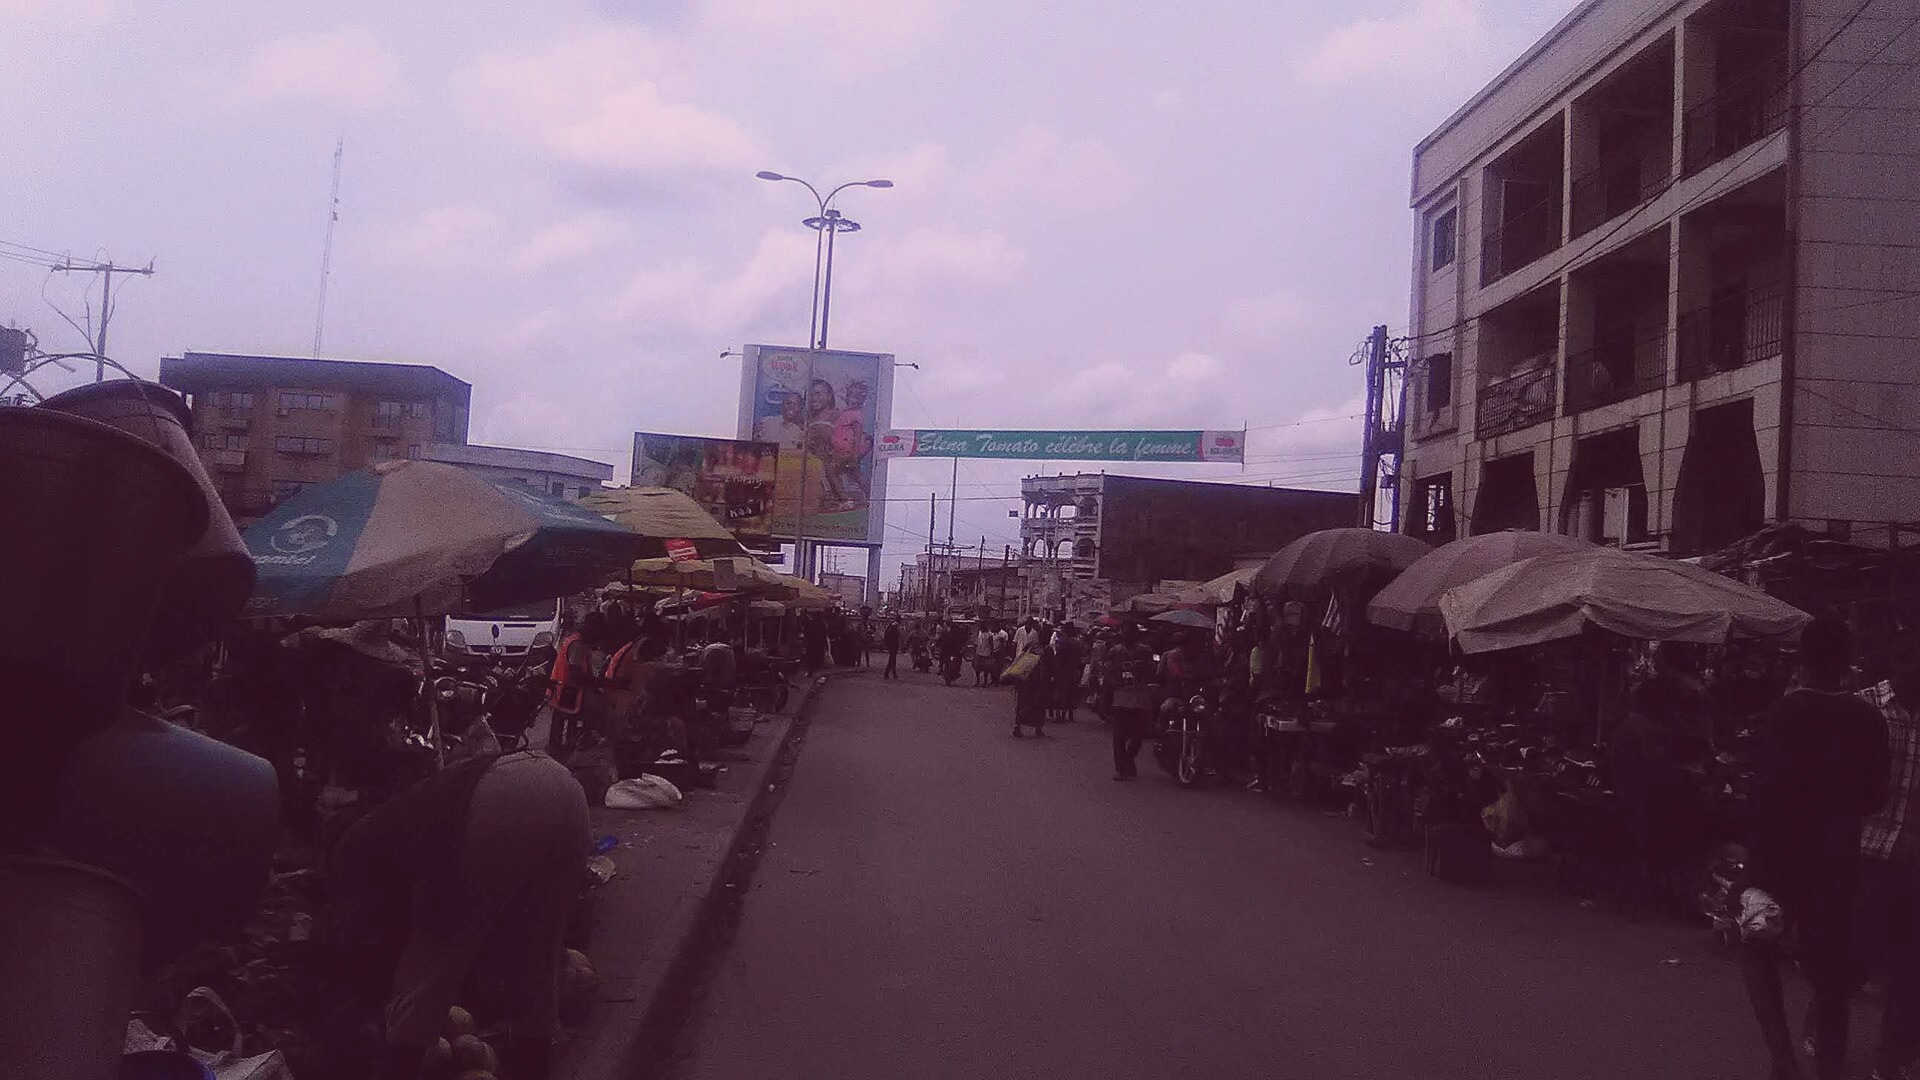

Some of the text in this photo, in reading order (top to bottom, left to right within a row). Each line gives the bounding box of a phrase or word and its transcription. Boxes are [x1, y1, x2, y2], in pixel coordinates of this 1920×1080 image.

[919, 432, 967, 452] Elena
[976, 433, 1040, 453] Tomato
[1110, 437, 1127, 453] la
